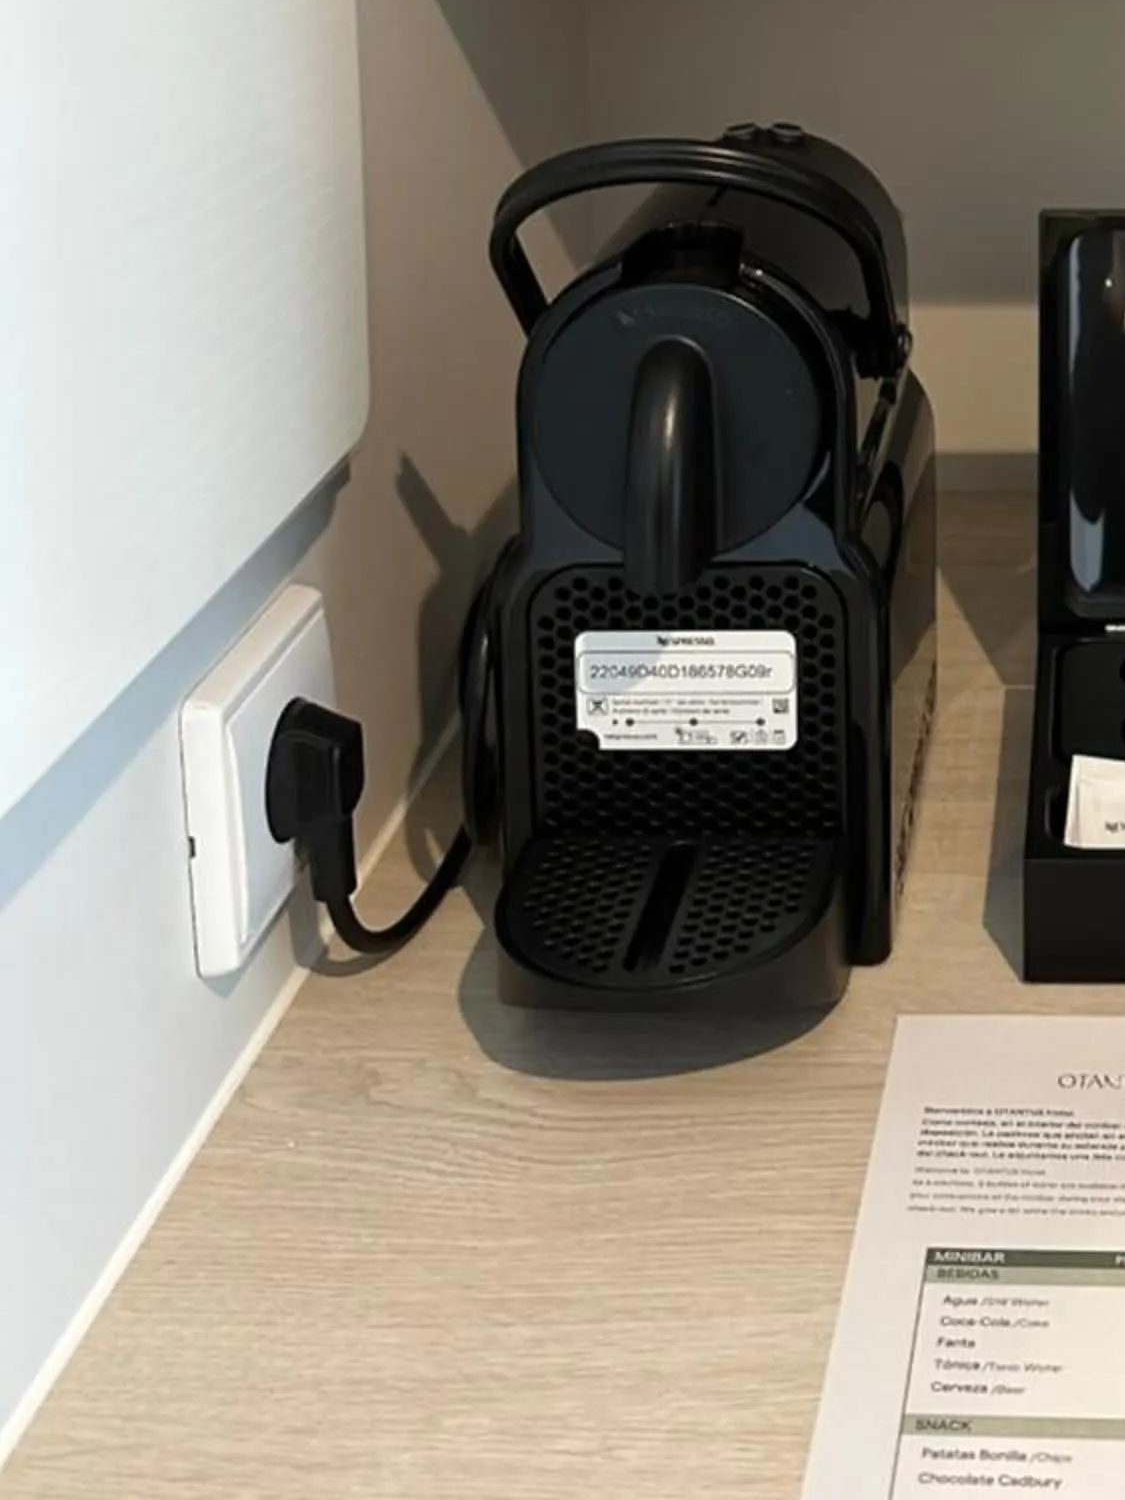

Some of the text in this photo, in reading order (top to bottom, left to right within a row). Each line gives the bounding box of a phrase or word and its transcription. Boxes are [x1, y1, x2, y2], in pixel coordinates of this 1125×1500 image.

[935, 1250, 1006, 1266] MINIBAR
[937, 1268, 1000, 1281] BEBIDAS
[943, 1295, 979, 1308] Agua
[940, 1315, 1011, 1329] Coca-Cola
[936, 1336, 977, 1350] Fanta
[934, 1357, 981, 1373] Tónica
[930, 1380, 989, 1395] Cerveza
[914, 1418, 973, 1434] SNACK
[921, 1445, 976, 1462] Patatas
[978, 1447, 1028, 1464] Bonilla
[917, 1471, 1064, 1492] Chocolate Cadbury
